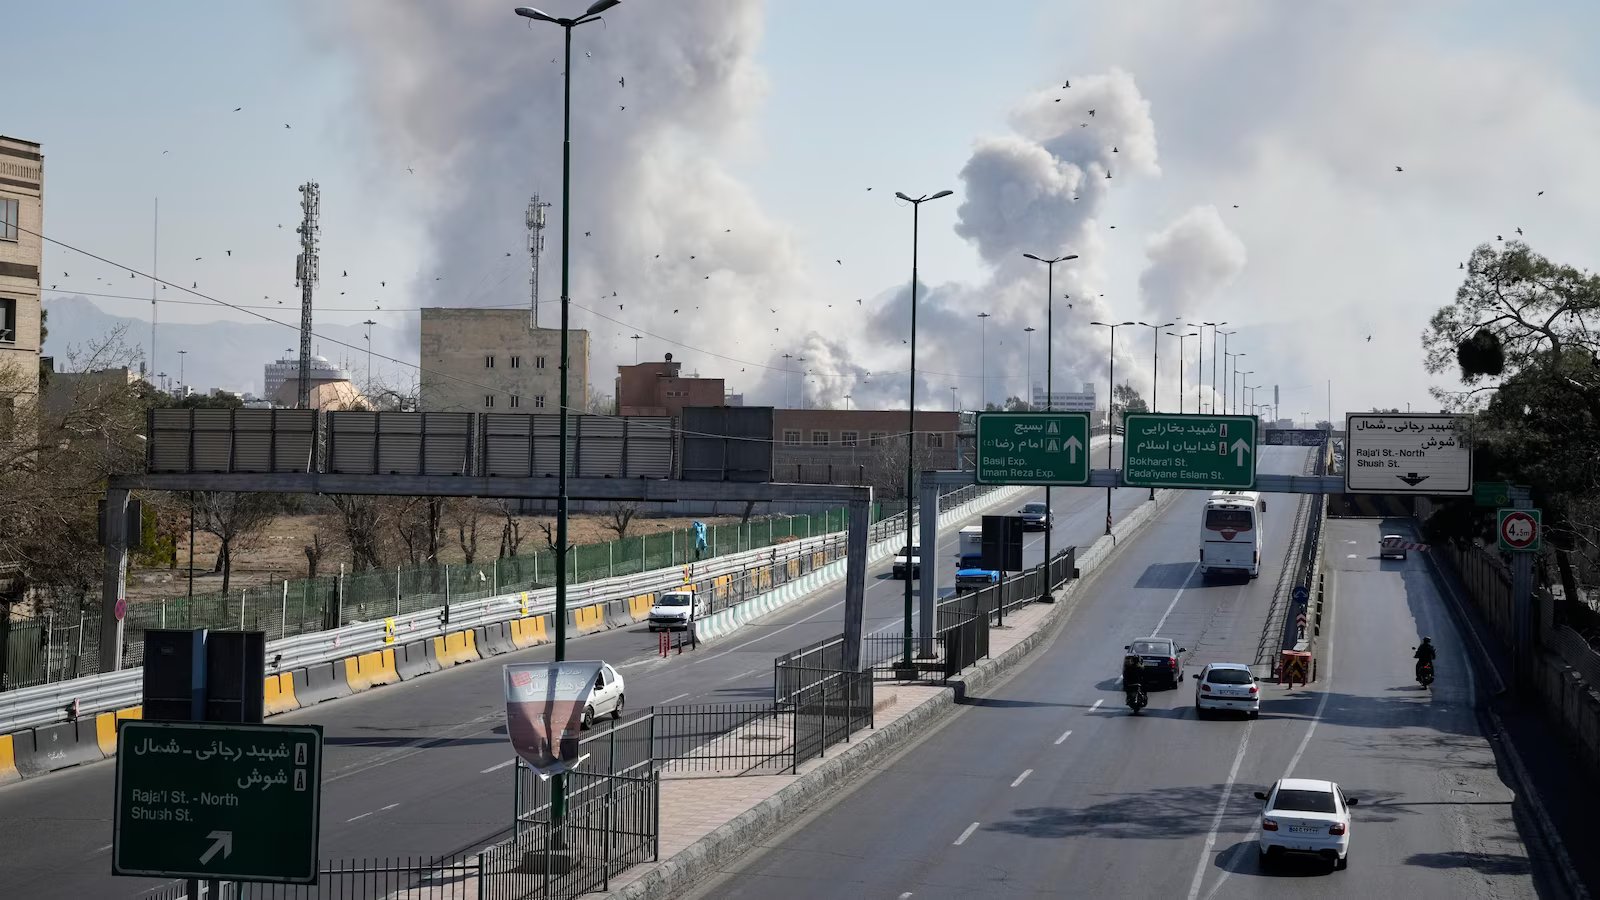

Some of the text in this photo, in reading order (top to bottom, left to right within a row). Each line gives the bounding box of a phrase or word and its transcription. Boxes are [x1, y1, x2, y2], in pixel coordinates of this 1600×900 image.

[1014, 423, 1043, 435] بسیج
[1141, 422, 1217, 436] شهید بخارایی
[1356, 419, 1386, 431] شمال
[1394, 420, 1425, 433] رجائی
[1427, 420, 1456, 433] شهید
[1018, 438, 1044, 453] امام
[1137, 440, 1217, 454] فداییان اسلام
[1421, 436, 1455, 450] شوش
[1356, 448, 1380, 457] Raja'i
[1399, 449, 1425, 457] North
[983, 456, 1027, 467] Basij Exp.
[1129, 456, 1188, 467] Bokhara'i St.
[1357, 459, 1400, 468] Shush St.
[983, 468, 1056, 479] Imam Reza Exp.
[1180, 470, 1208, 480] Eslam
[1211, 471, 1225, 480] St.
[134, 738, 180, 756] شمال
[195, 741, 243, 762] رجائی
[246, 743, 290, 762] شهید
[237, 768, 288, 791] شوش
[132, 788, 167, 805] Raja'i
[171, 790, 189, 804] St.
[201, 791, 239, 806] North
[131, 806, 193, 822] Shush St.
